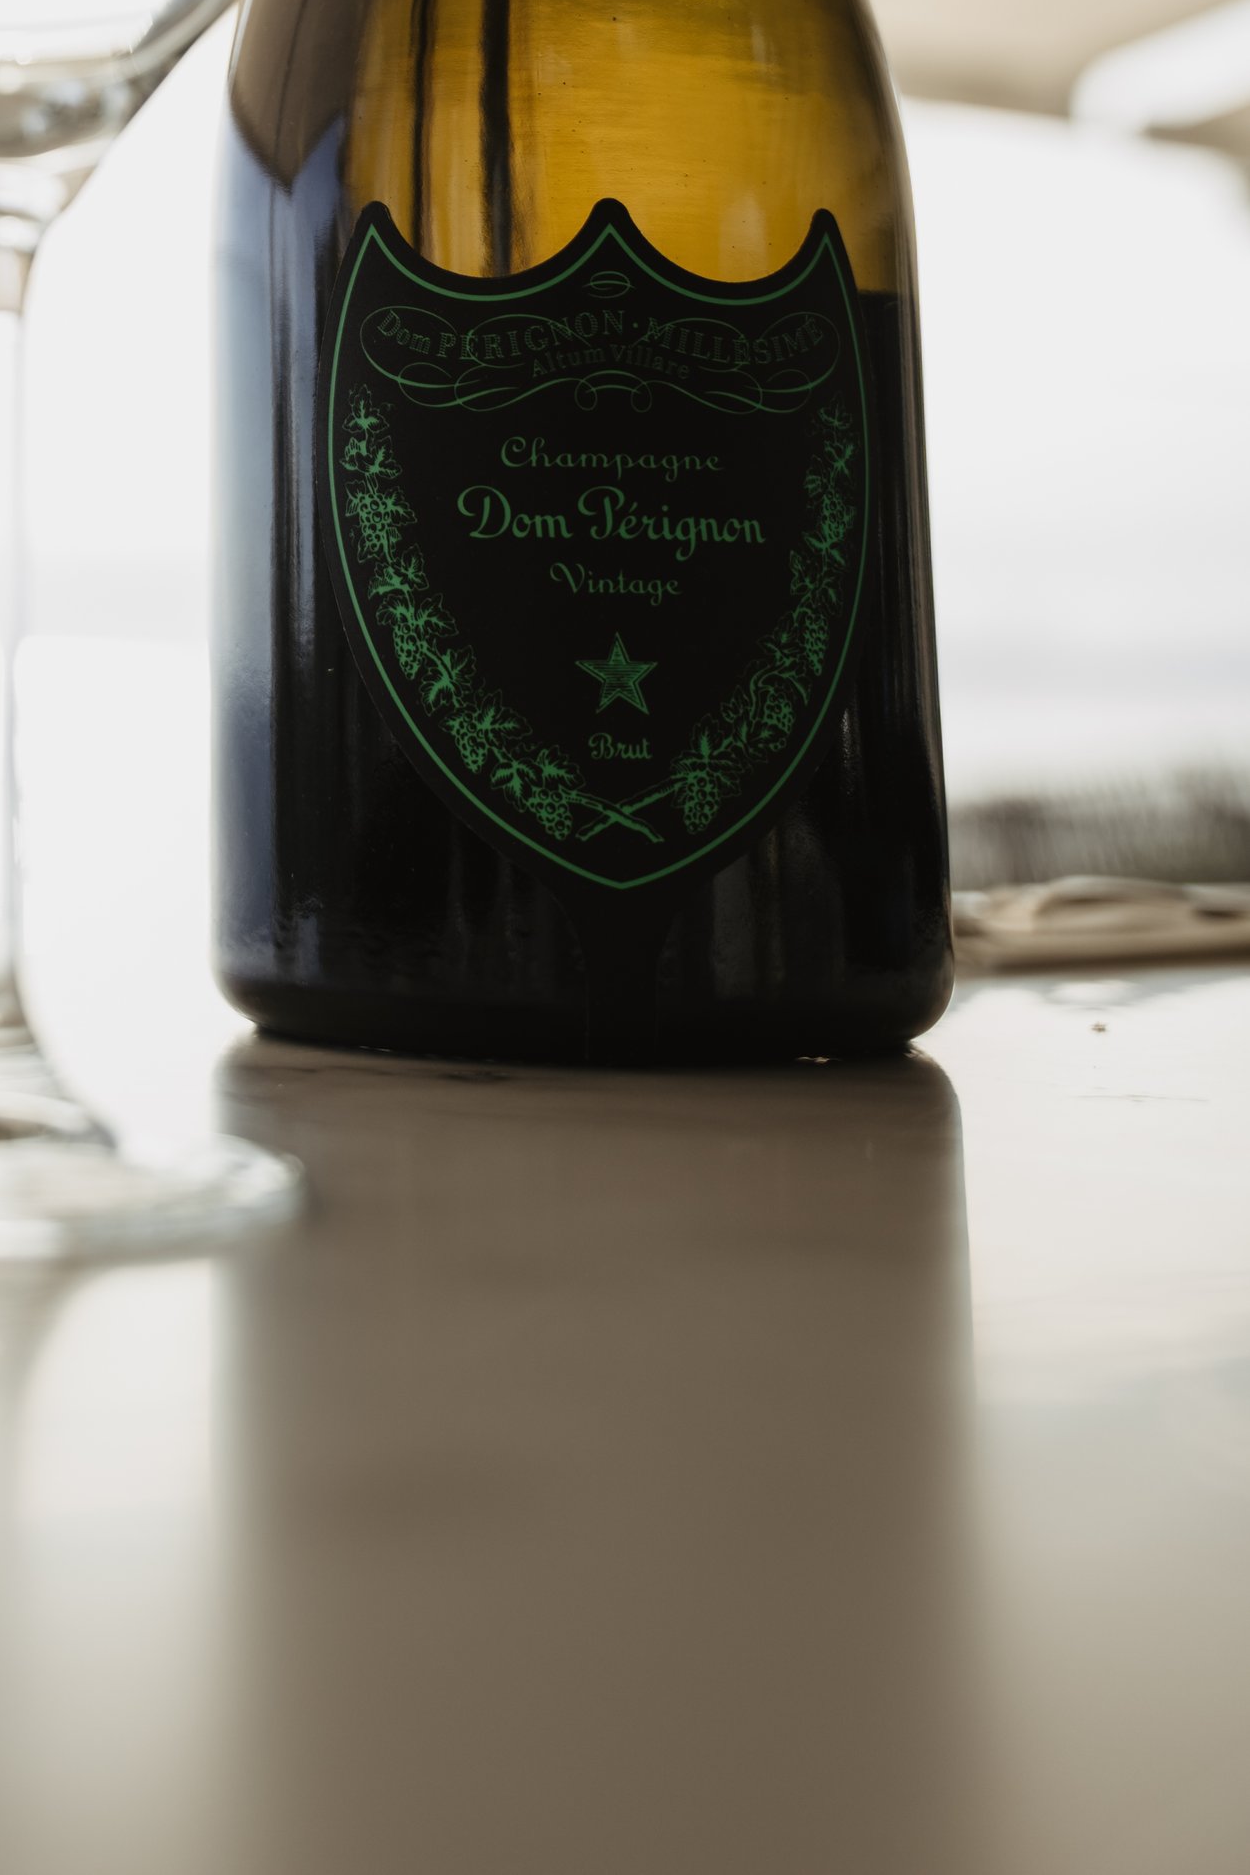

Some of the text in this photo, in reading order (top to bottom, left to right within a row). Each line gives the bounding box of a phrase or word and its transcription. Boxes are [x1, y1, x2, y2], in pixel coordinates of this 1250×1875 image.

[376, 308, 431, 355] Dom
[532, 343, 690, 380] Altum Villare
[500, 436, 724, 482] Champagne
[456, 485, 766, 561] Dom Pérignon
[549, 562, 681, 606] Vintage
[587, 731, 653, 761] Brut
